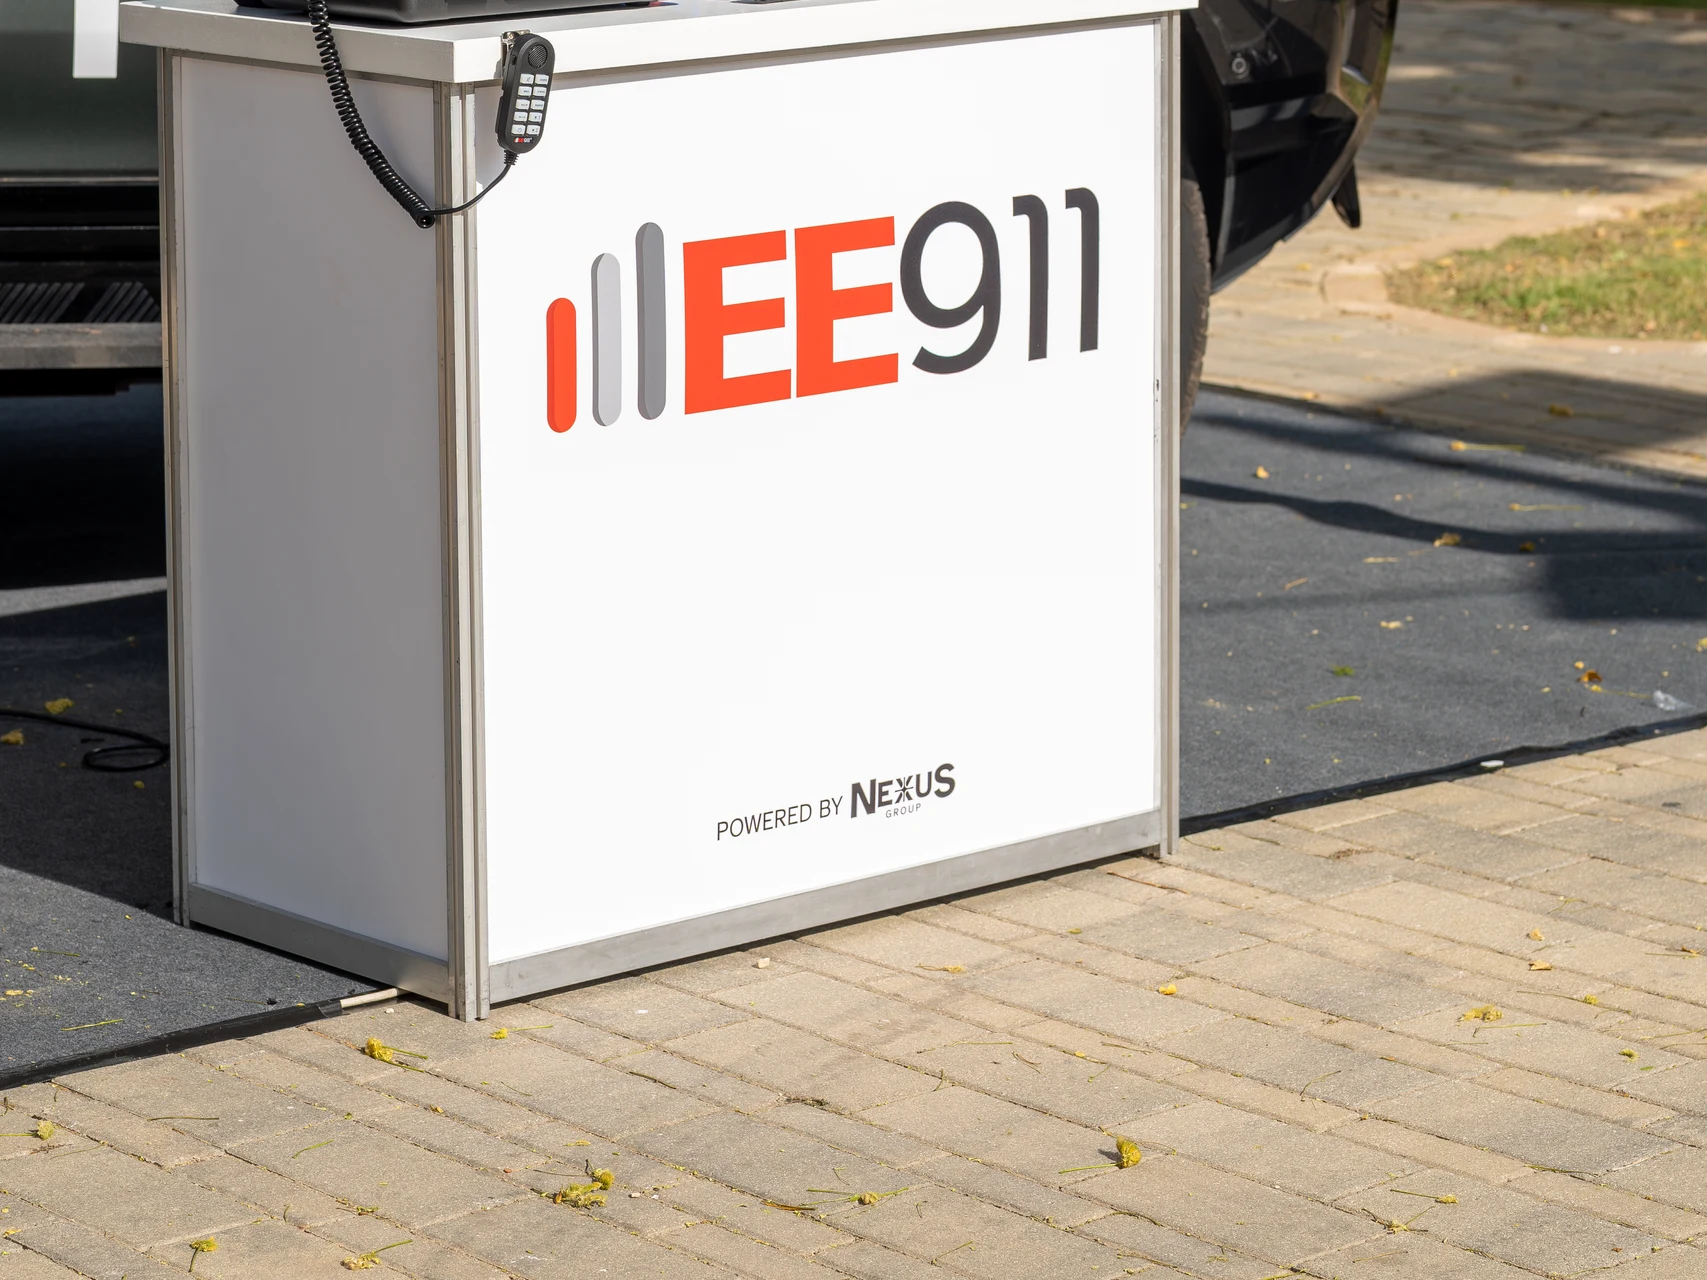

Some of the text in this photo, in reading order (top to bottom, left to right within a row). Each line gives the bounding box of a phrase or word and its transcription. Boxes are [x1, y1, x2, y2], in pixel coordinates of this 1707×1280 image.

[682, 187, 1100, 416] EE911
[717, 763, 956, 841] POWERED BY NEXUS
[885, 803, 922, 818] GROUP
